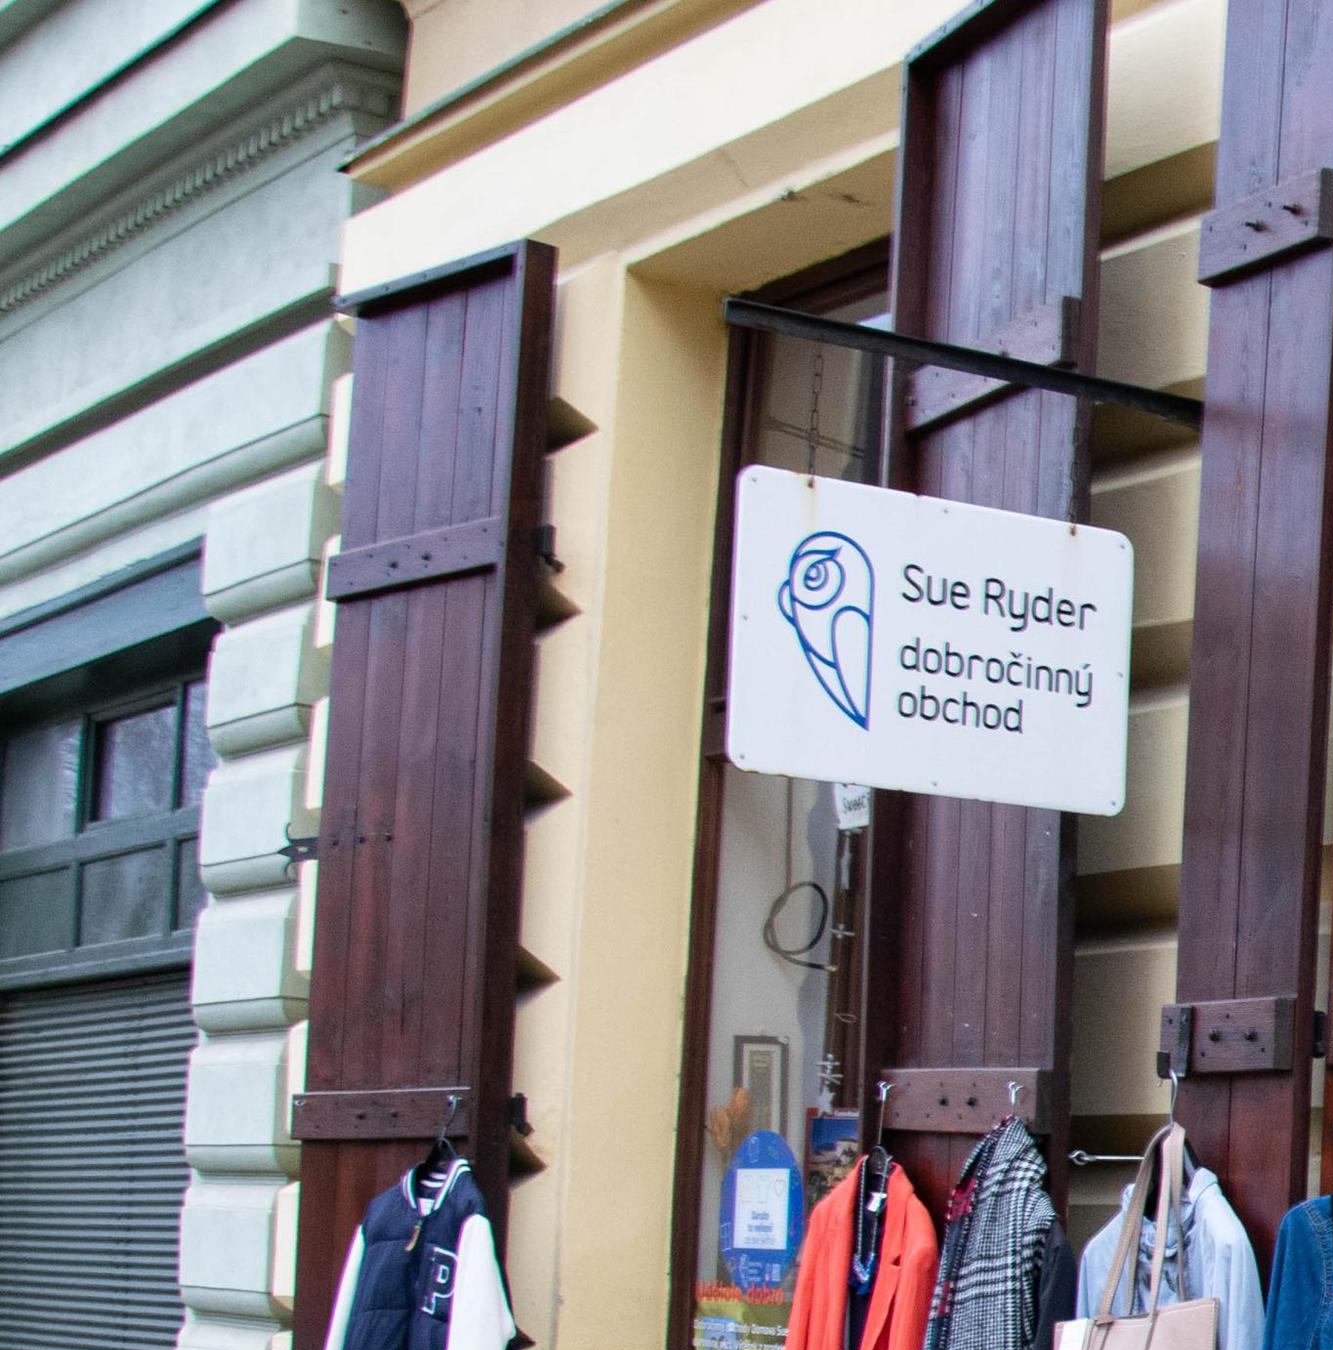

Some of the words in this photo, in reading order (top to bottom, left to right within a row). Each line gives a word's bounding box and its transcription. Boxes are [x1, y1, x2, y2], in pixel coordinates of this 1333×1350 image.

[901, 563, 971, 611] Sue
[983, 577, 1098, 633] Ryder
[899, 636, 1094, 708] dobročinný
[898, 684, 1024, 734] obchod
